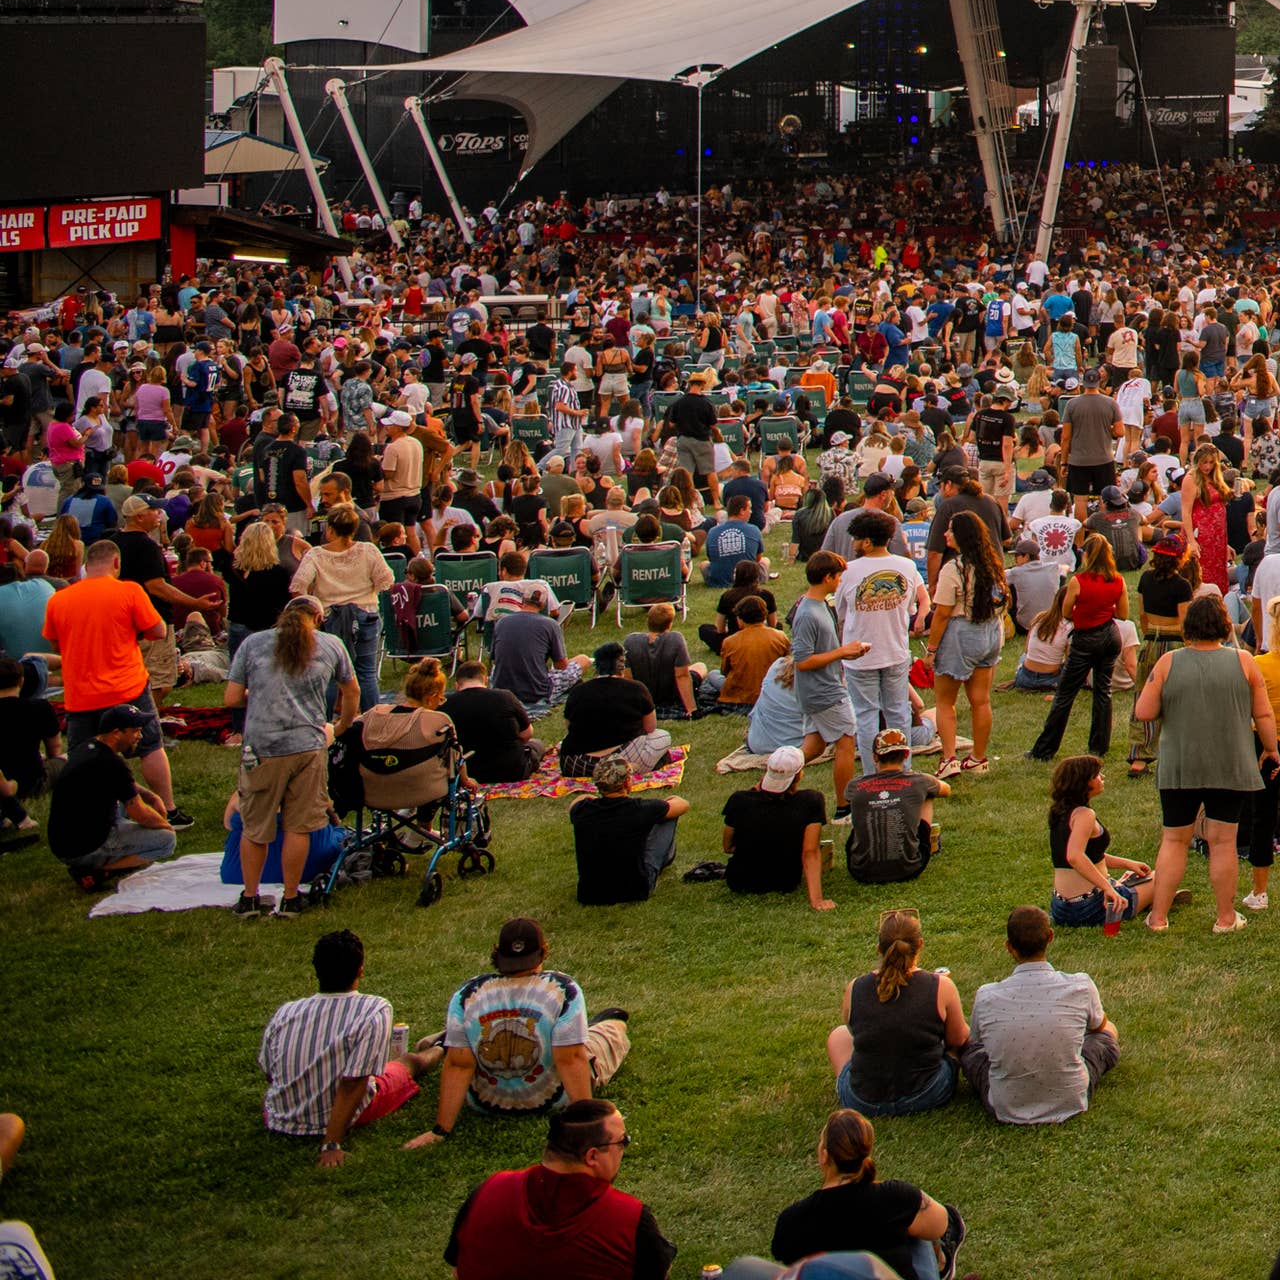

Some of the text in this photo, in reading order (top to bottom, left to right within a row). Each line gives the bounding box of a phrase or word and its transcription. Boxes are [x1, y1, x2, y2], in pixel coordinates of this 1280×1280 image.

[0, 212, 35, 228] HAIR
[61, 204, 147, 225] PRE-PAID
[70, 221, 139, 241] PICK UP
[518, 429, 543, 437] RENTAL
[632, 567, 671, 581] RENTAL
[416, 613, 439, 628] TAL
